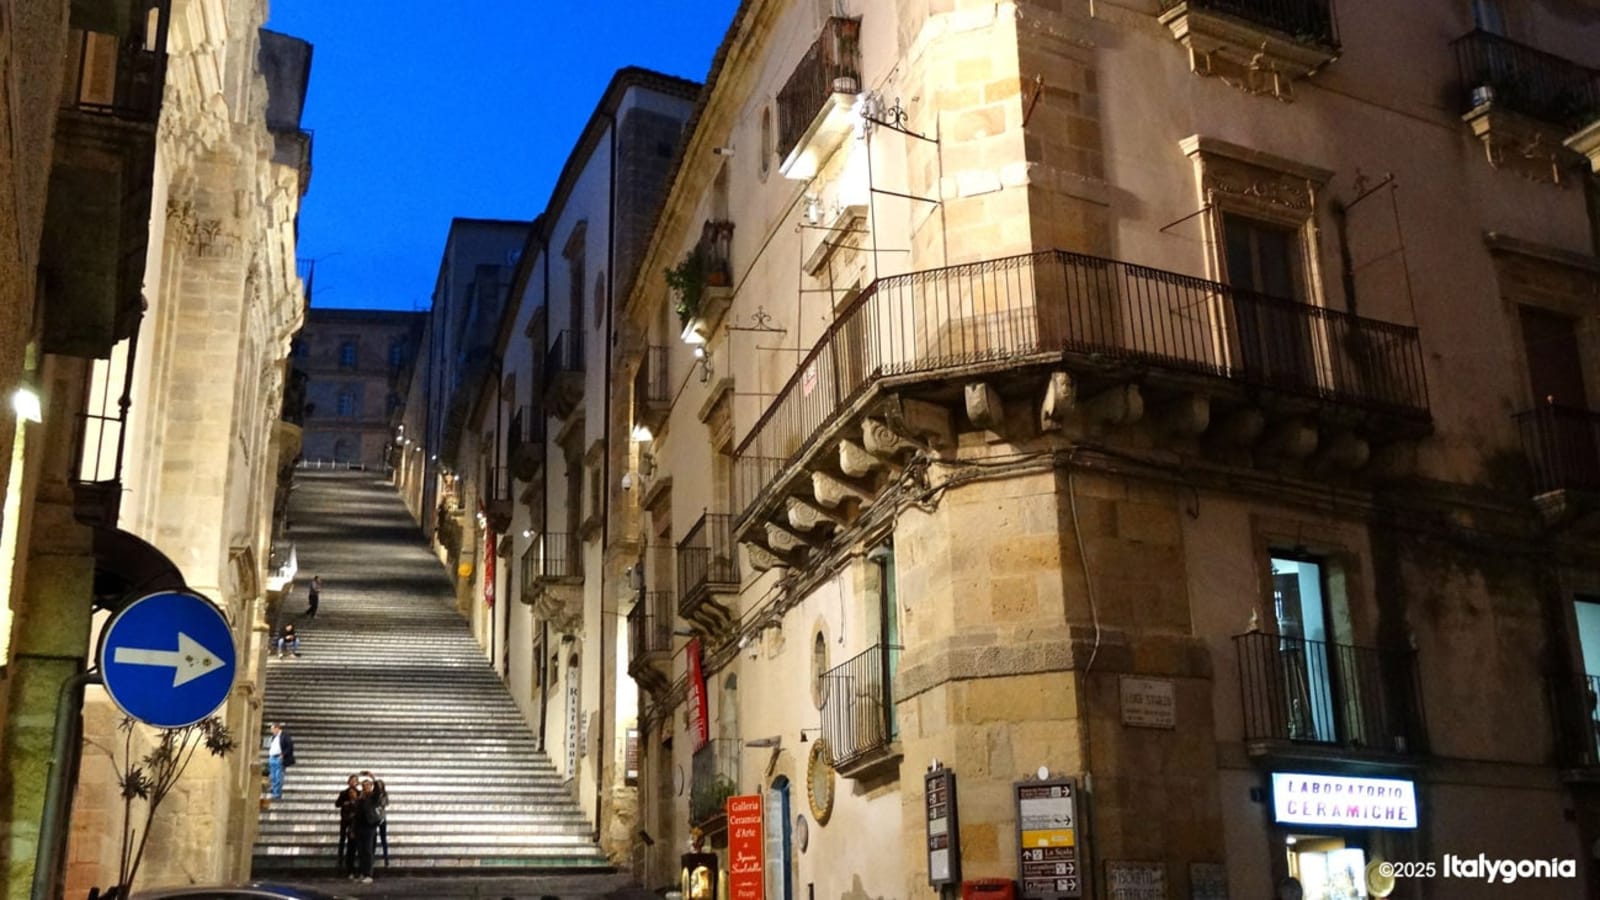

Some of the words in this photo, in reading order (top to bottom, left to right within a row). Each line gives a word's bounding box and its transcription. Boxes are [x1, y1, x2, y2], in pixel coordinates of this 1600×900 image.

[568, 687, 578, 775] Ristorante
[1288, 780, 1403, 798] LABORATORIO
[731, 801, 758, 811] Galleria
[1287, 800, 1408, 821] CERAMICHE
[730, 815, 761, 825] Ceramica
[735, 828, 756, 838] d'Arte
